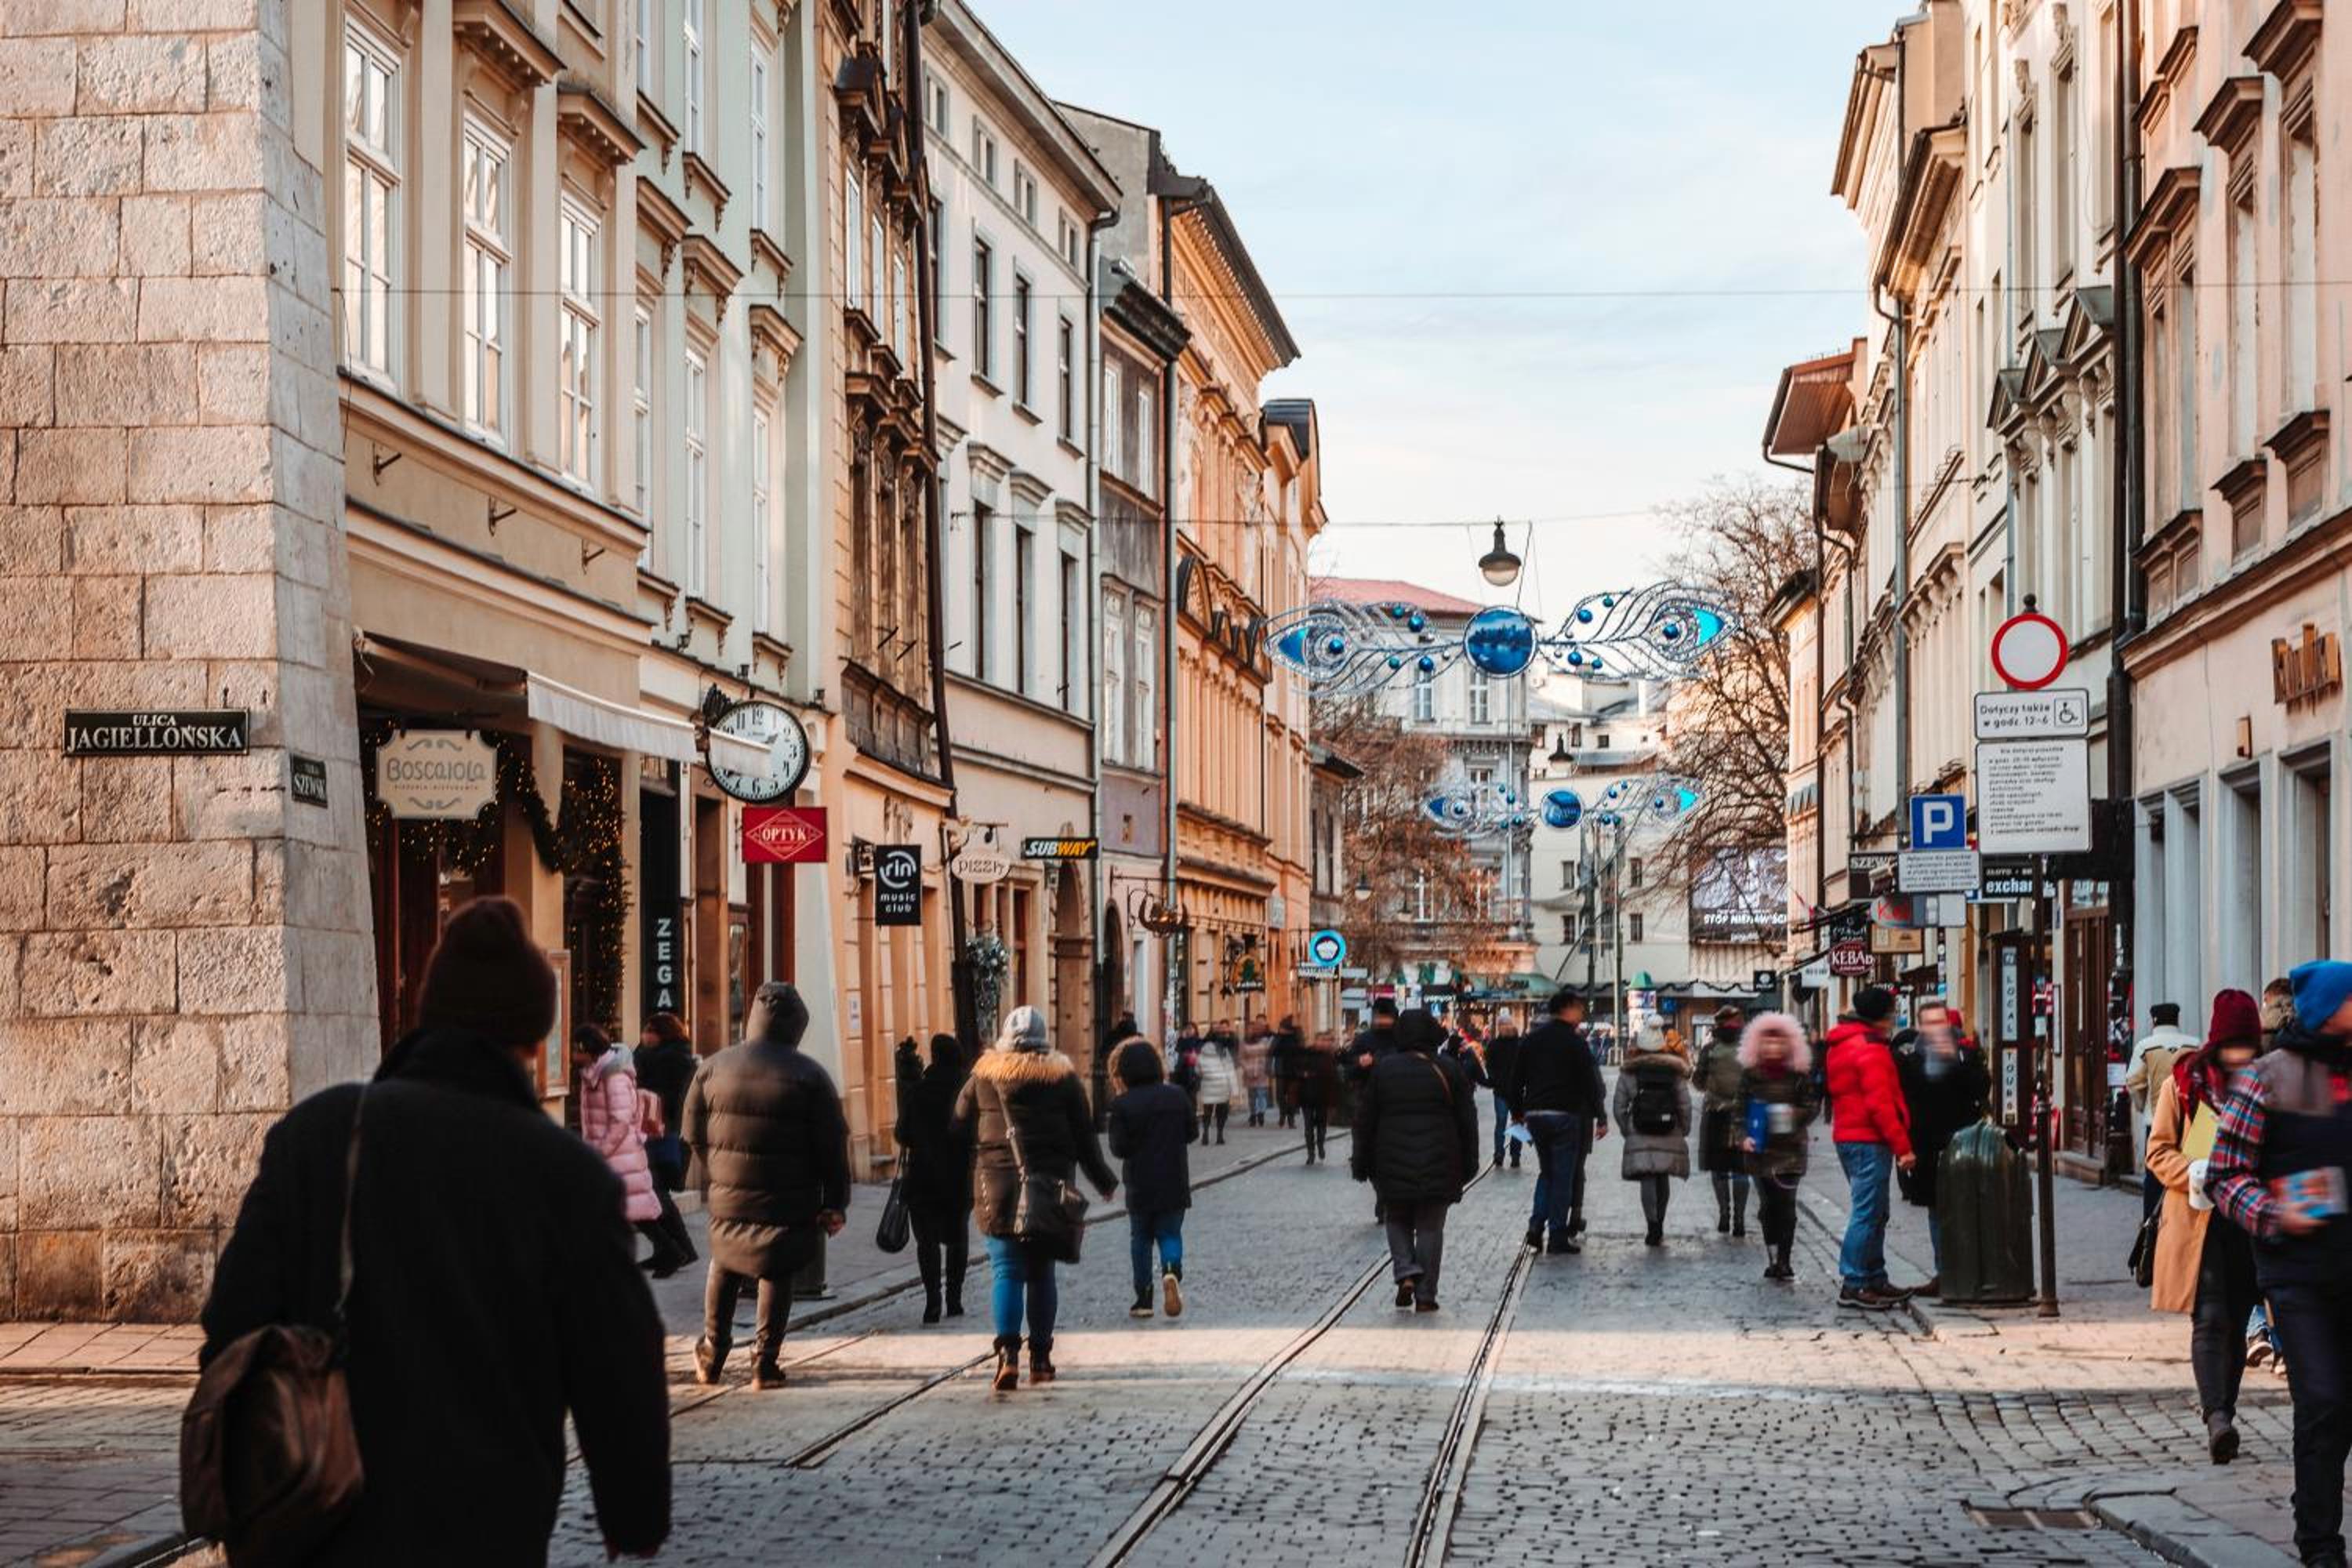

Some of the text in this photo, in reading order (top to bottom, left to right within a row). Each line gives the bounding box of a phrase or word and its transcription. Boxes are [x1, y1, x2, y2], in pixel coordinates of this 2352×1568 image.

[753, 707, 764, 725] 12
[1980, 704, 2019, 717] Dotyczy
[132, 713, 176, 727] ULICA
[67, 723, 242, 753] JAGIELLOŃSKA
[1922, 801, 1954, 844] P
[762, 828, 807, 841] OPTYK
[1025, 840, 1096, 856] SUBWAY
[880, 892, 916, 902] music
[885, 902, 912, 913] club
